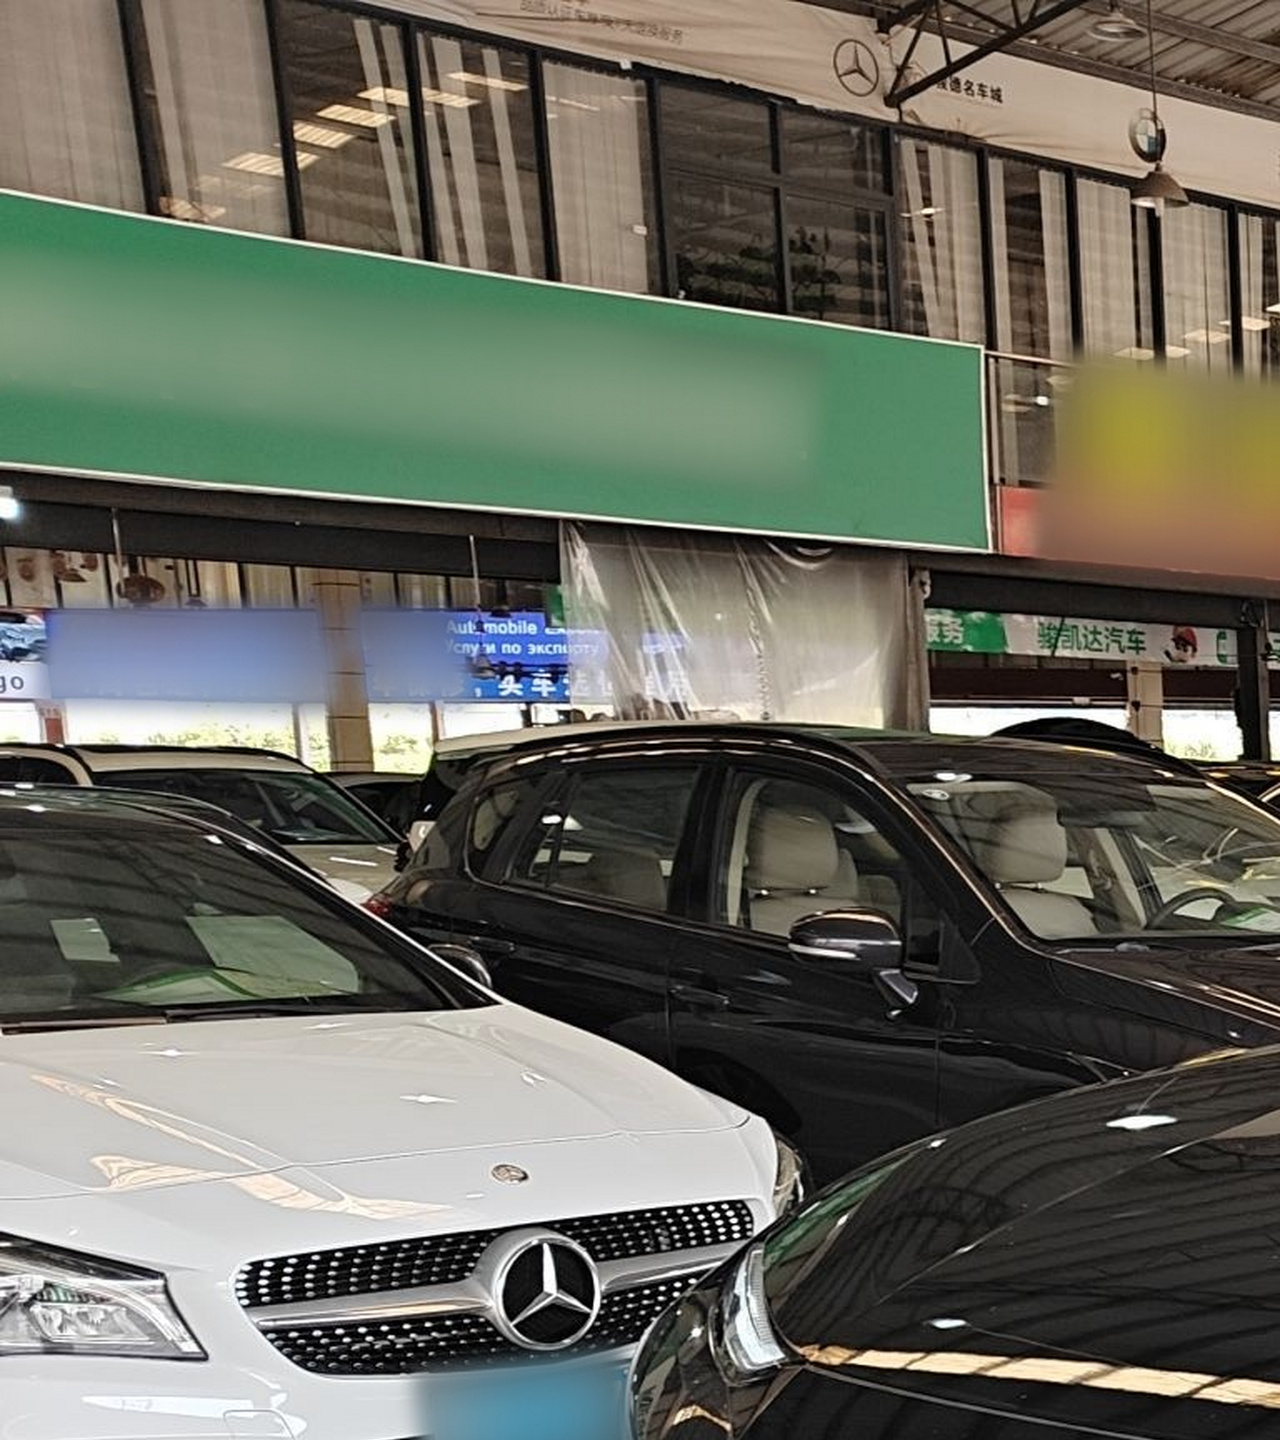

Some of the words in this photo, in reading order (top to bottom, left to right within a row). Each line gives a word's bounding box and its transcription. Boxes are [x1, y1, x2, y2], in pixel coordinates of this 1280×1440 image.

[446, 619, 538, 634] Autmobile
[1038, 622, 1147, 655] 骏凯达汽车
[502, 643, 521, 654] по
